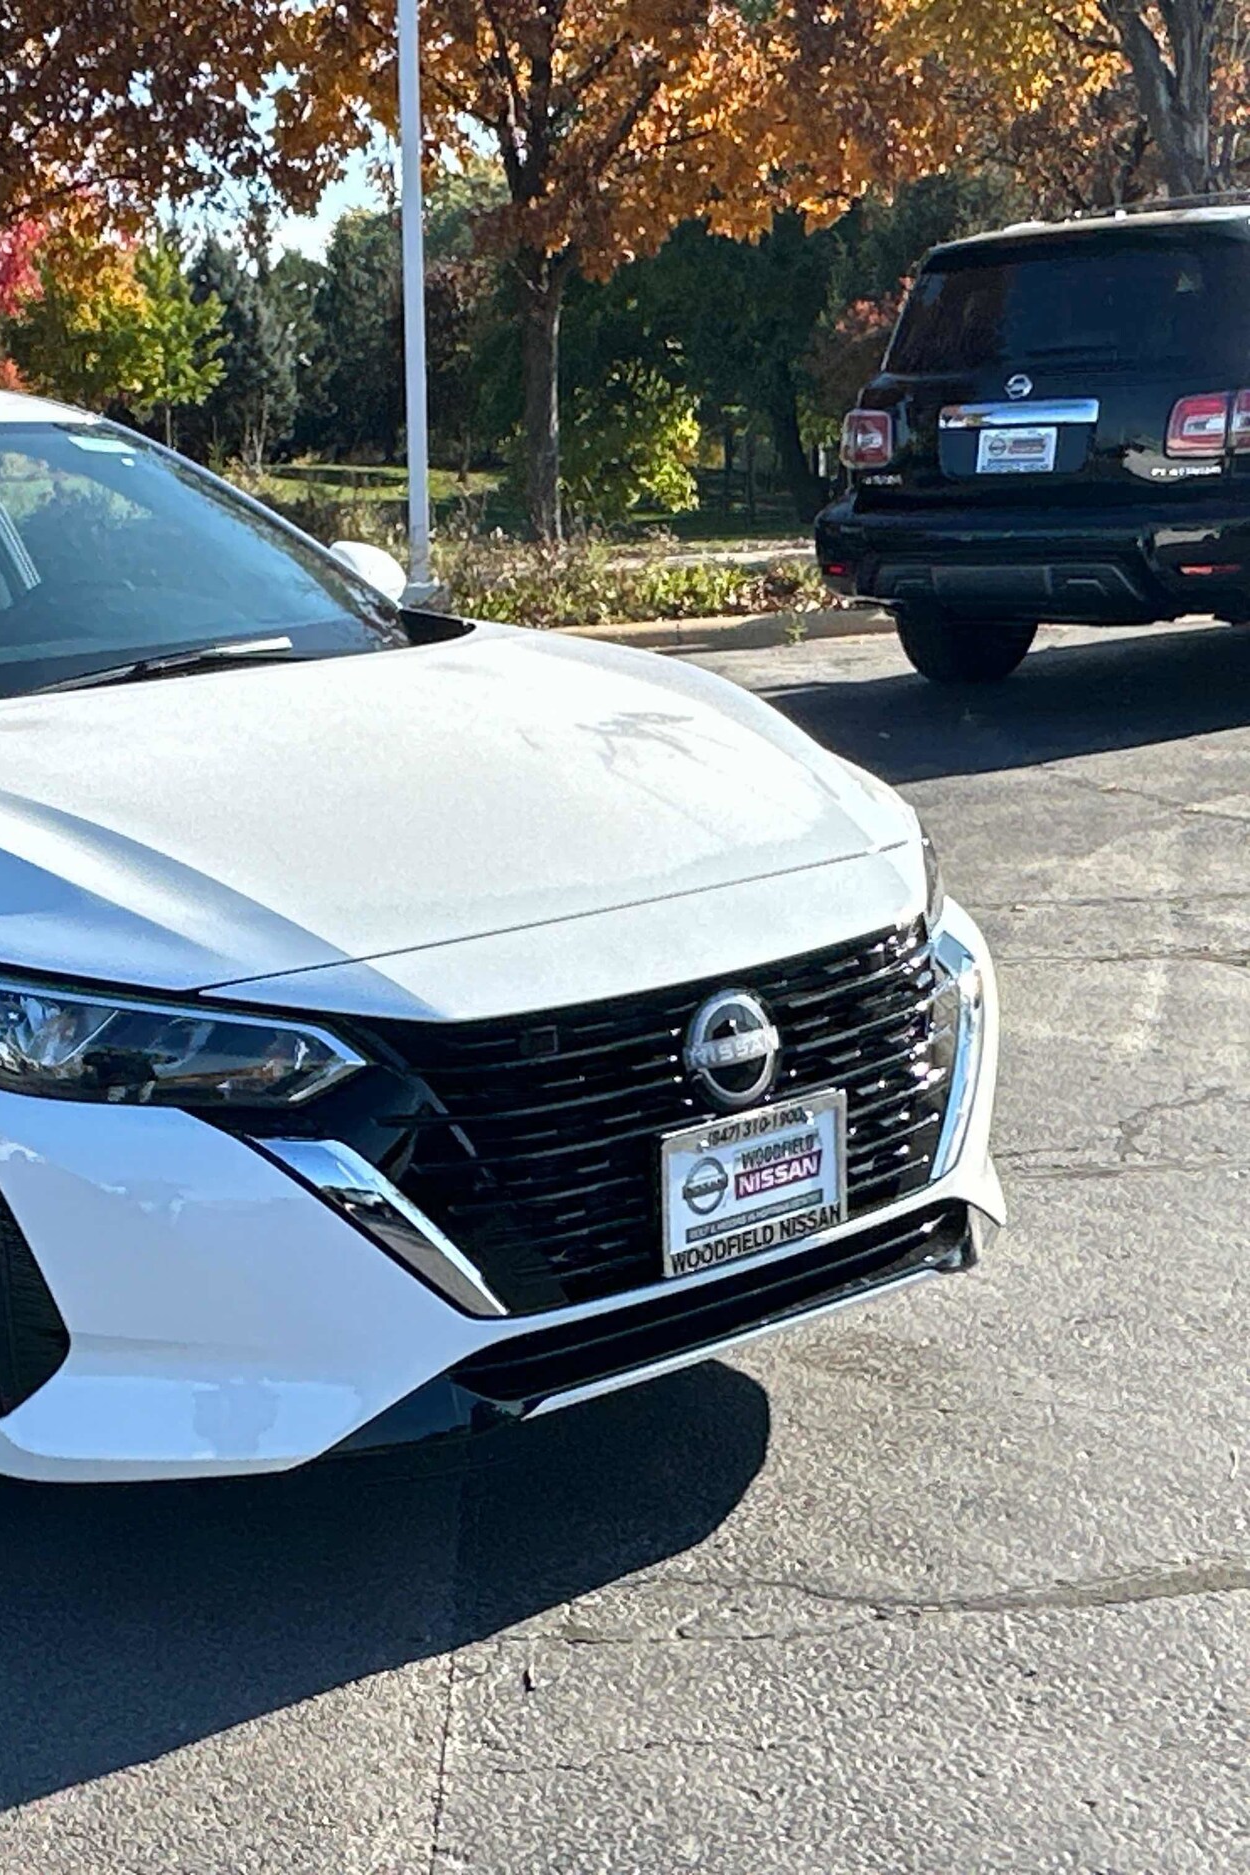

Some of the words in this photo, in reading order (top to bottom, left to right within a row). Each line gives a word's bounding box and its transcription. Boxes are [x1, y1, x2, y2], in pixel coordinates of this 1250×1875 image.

[740, 1132, 816, 1169] WOODFIELD
[738, 1154, 819, 1197] NISSAN
[670, 1224, 774, 1274] WOODFIELD
[779, 1202, 842, 1240] NISSAN
